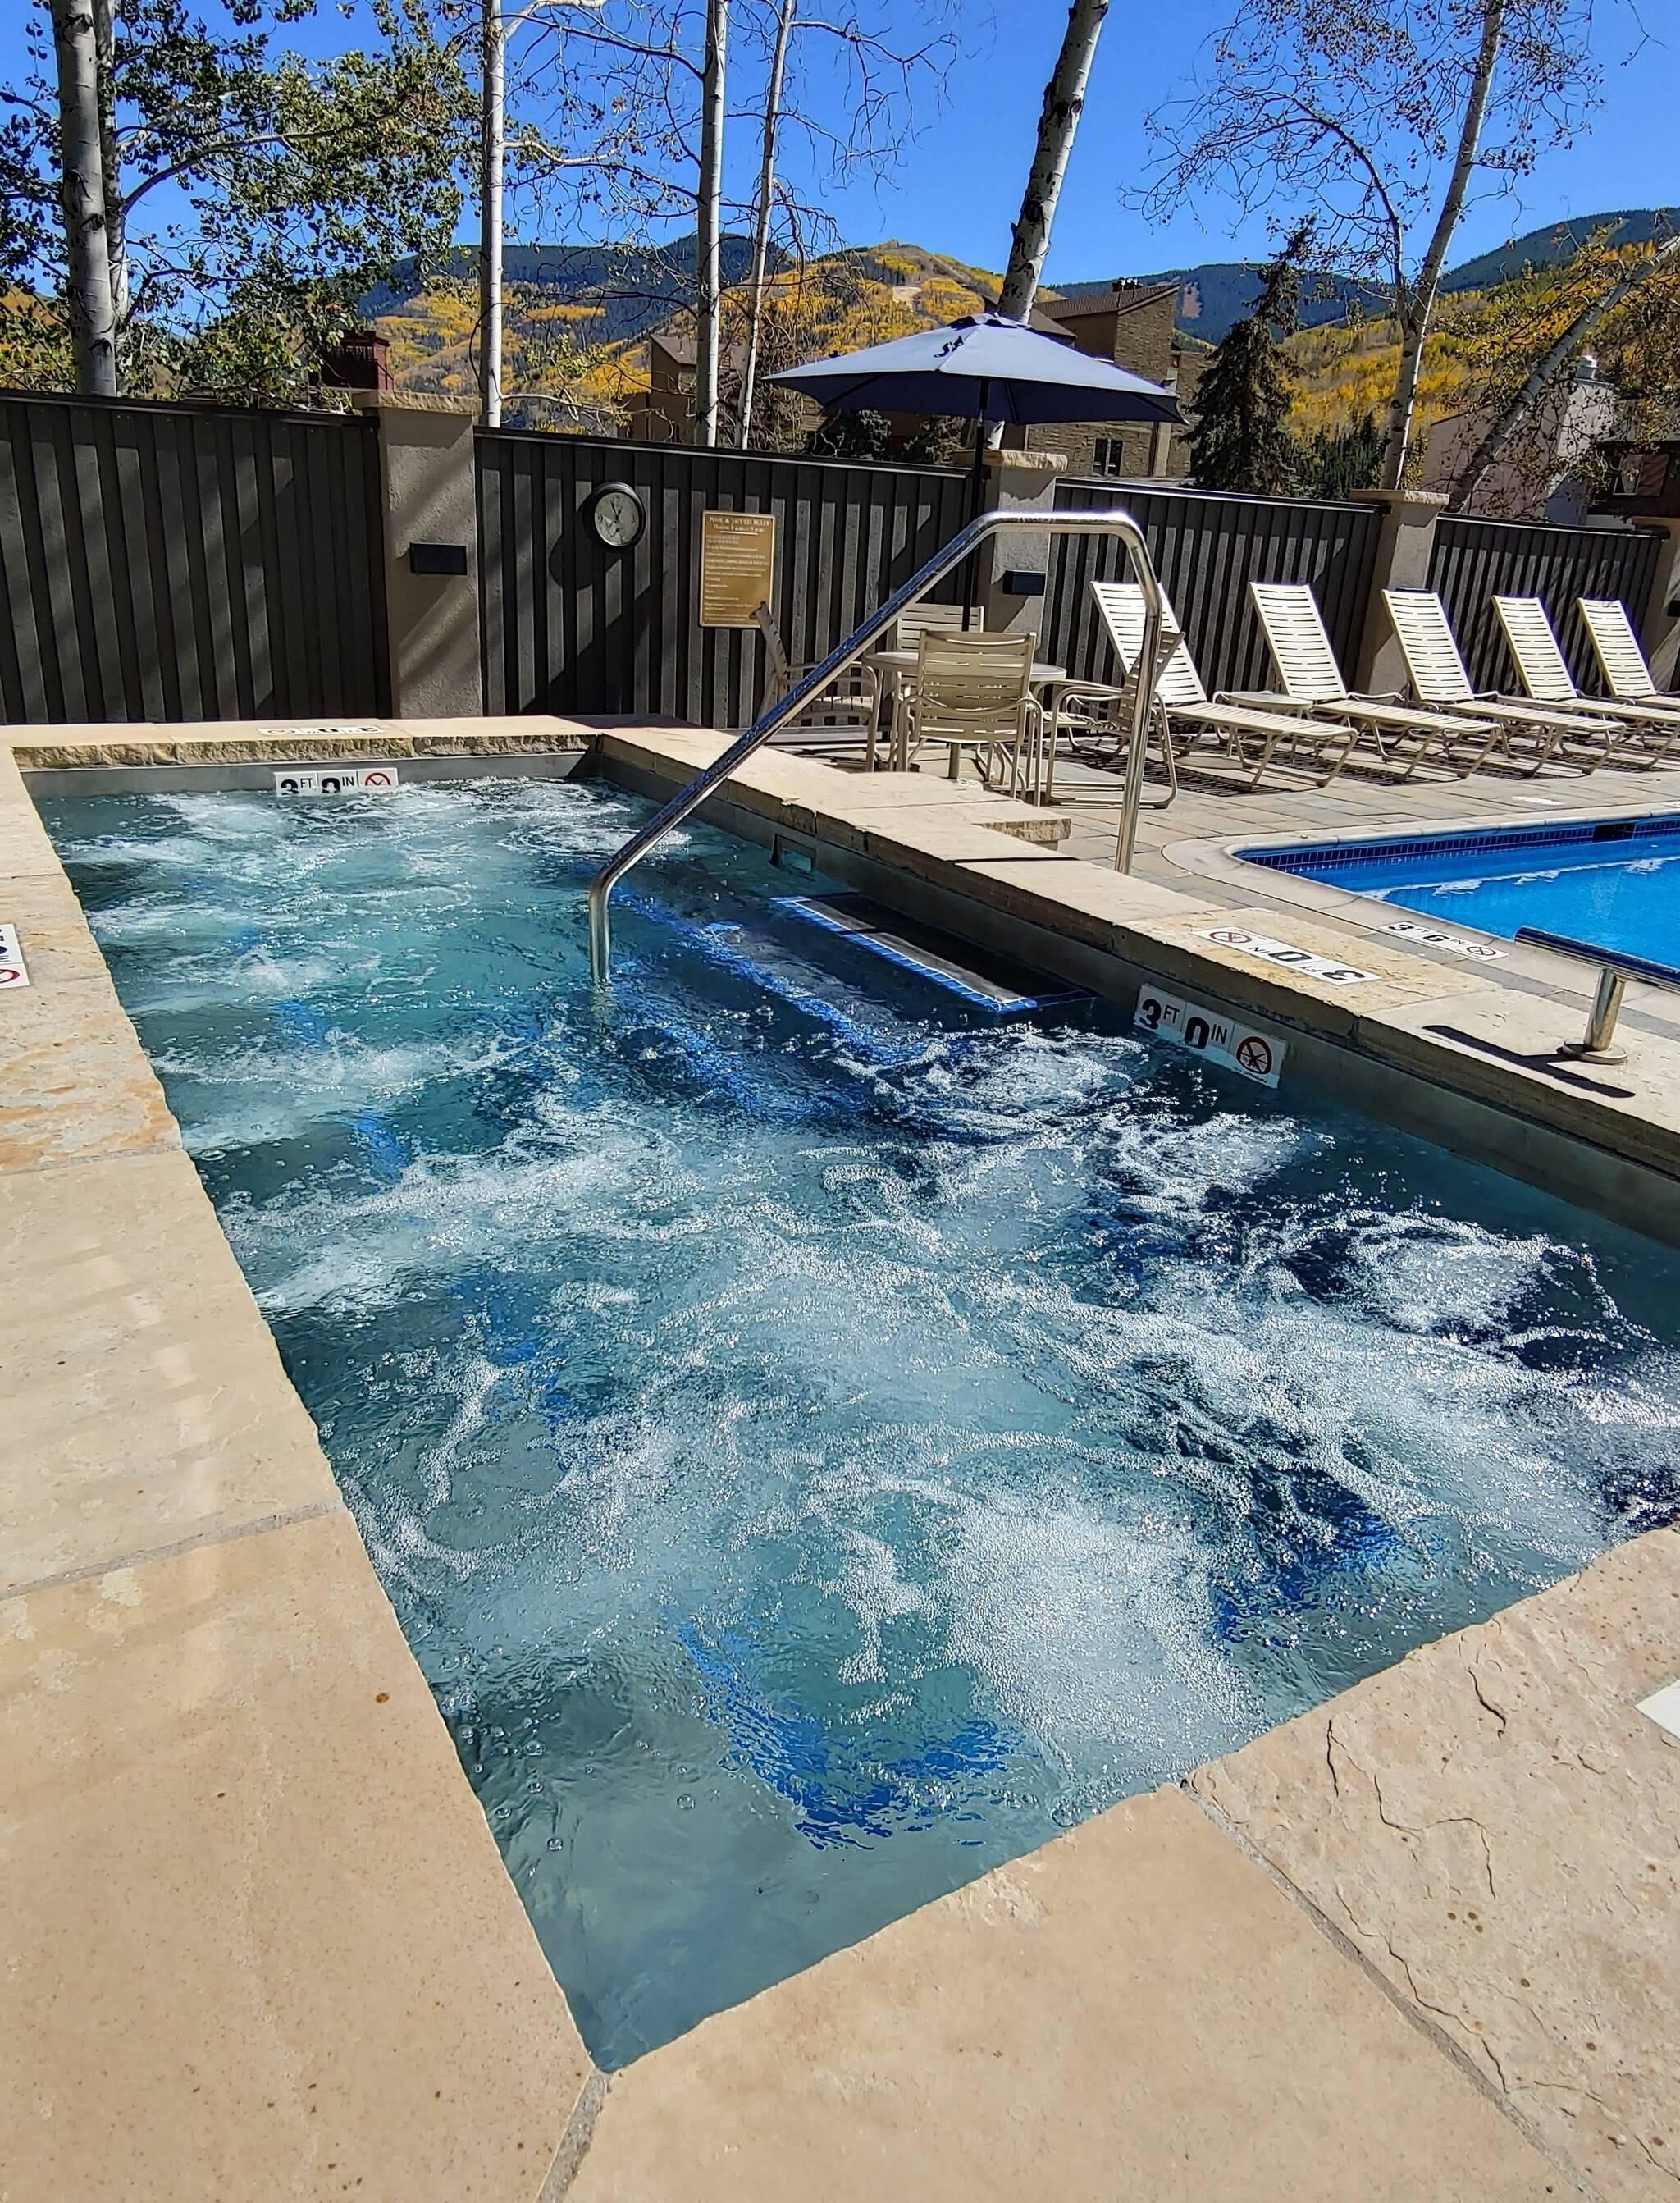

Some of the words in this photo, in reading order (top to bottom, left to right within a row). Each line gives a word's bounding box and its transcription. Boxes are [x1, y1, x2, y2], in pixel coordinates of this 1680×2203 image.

[300, 777, 313, 788] FT
[342, 776, 354, 787] IN
[1388, 923, 1414, 931] 3
[1249, 946, 1271, 954] IN
[1268, 950, 1313, 962] 0
[1297, 965, 1323, 973] FT
[1322, 969, 1366, 981] 3
[1139, 998, 1162, 1030] 3
[1163, 1004, 1180, 1024] FT
[1185, 1017, 1210, 1049] 0
[1211, 1024, 1228, 1044] IN
